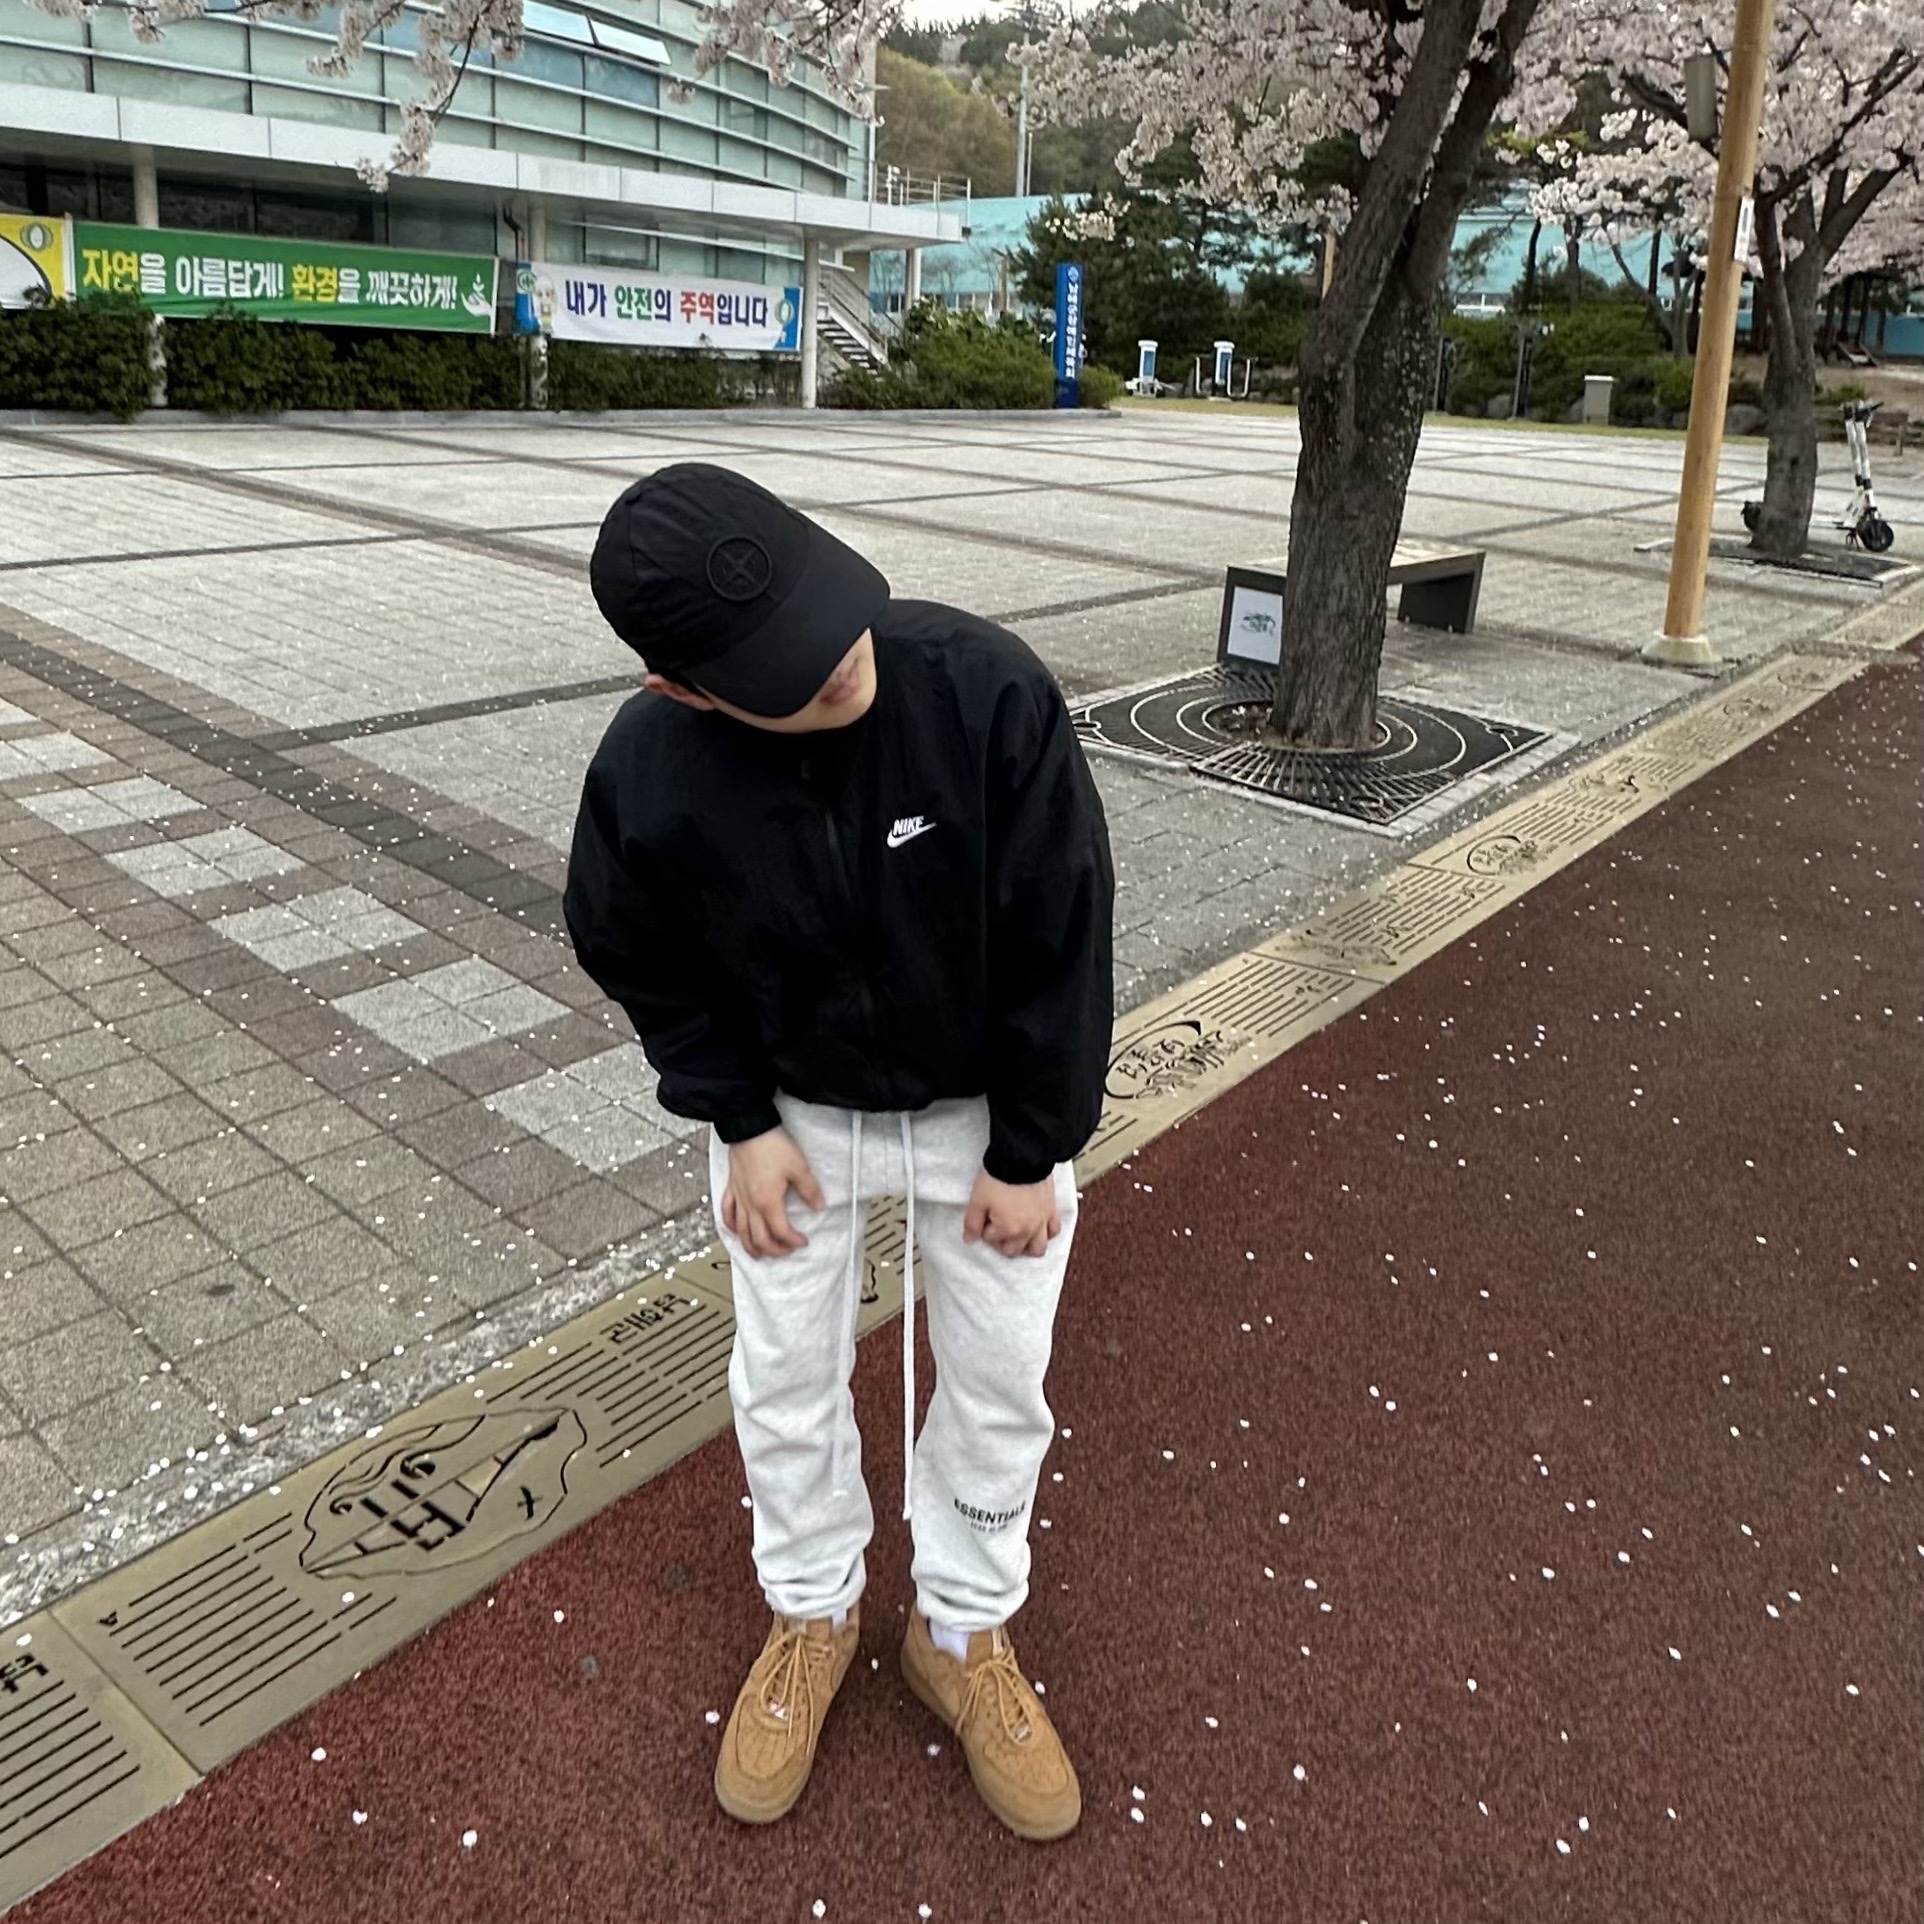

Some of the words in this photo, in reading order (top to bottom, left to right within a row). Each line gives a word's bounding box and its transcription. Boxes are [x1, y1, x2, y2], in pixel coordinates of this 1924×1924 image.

[82, 247, 167, 295] 자연을
[175, 255, 284, 300] 아름답게!
[291, 263, 362, 304] 환경을
[367, 270, 459, 310] 깨끗하게!
[565, 279, 607, 318] 내가
[614, 284, 672, 323] 안전의
[680, 290, 769, 328] 주역입니다
[893, 815, 925, 836] NIKE
